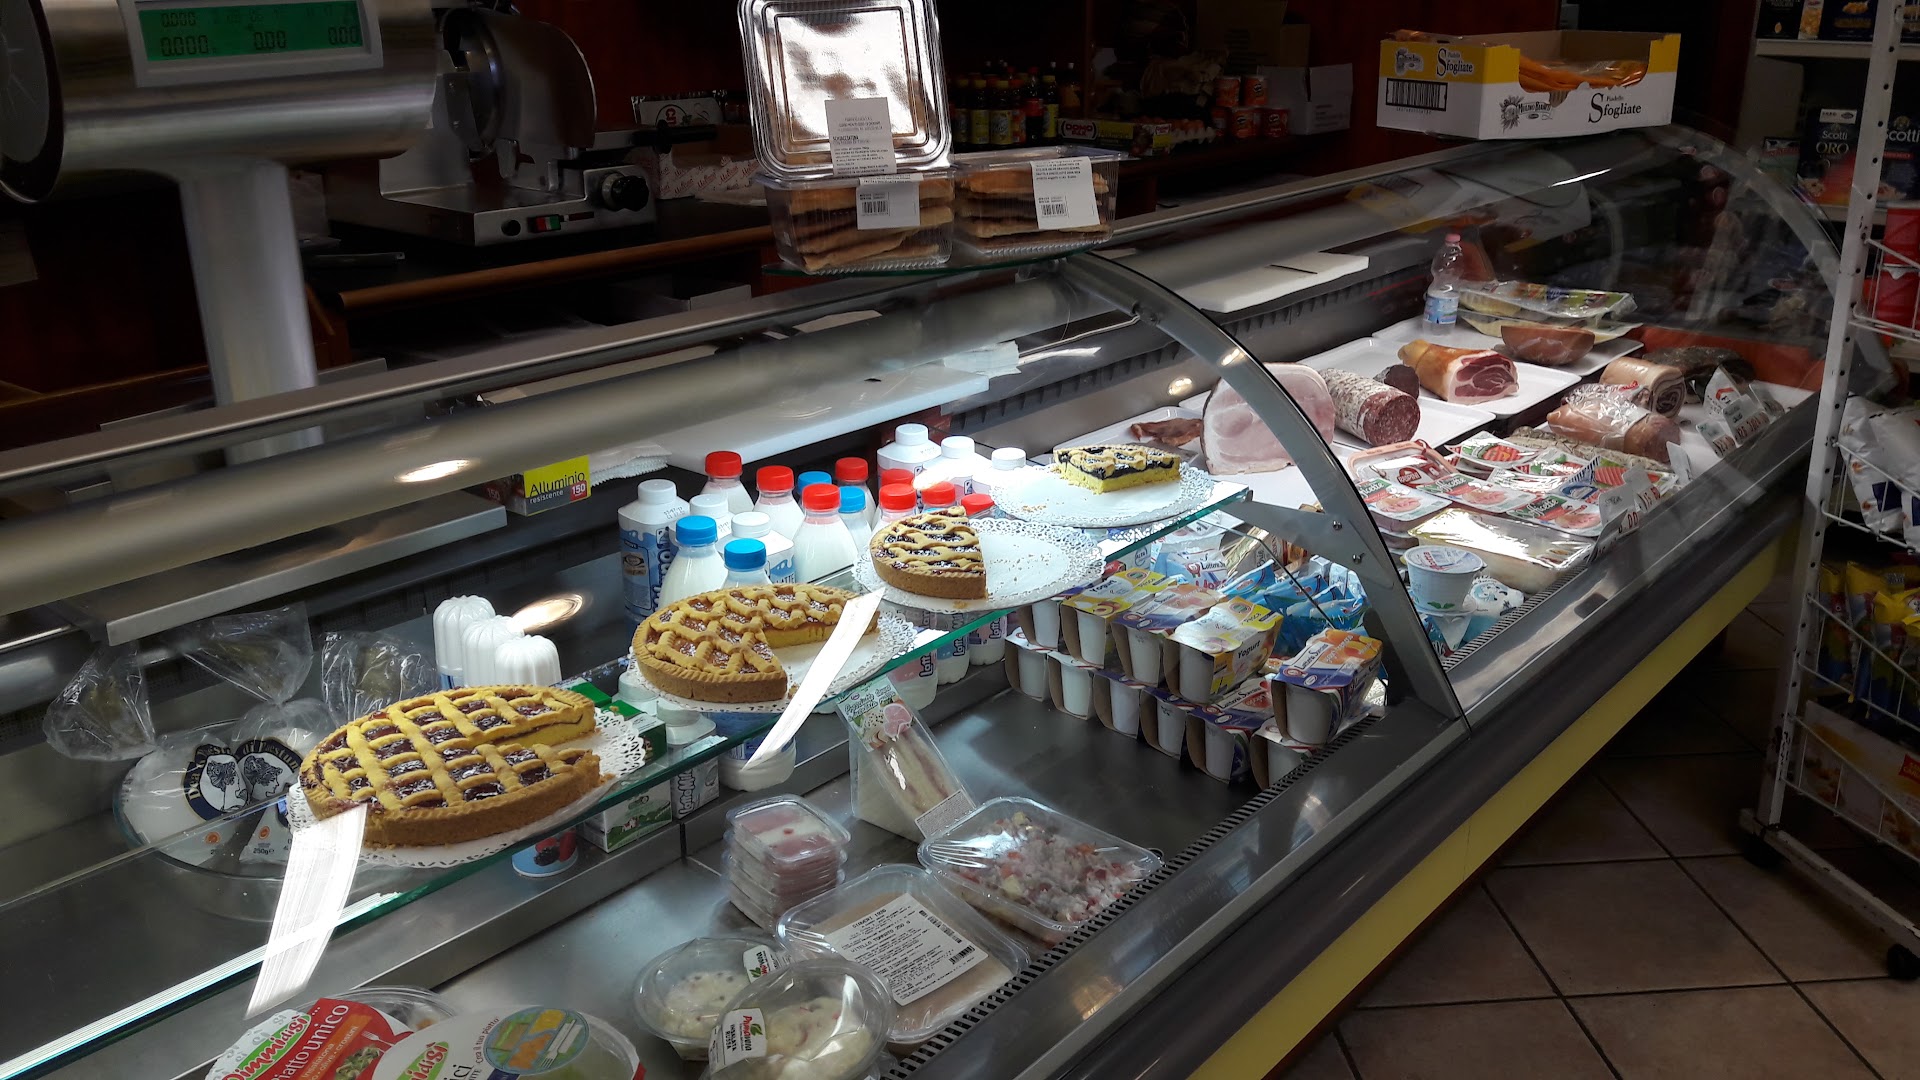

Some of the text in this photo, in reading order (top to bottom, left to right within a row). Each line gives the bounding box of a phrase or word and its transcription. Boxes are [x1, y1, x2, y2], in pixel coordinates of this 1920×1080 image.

[1436, 48, 1473, 77] Sfogliate
[1588, 92, 1641, 124] Sfogliate
[1822, 129, 1849, 141] Scotti
[1887, 128, 1920, 143] cotti
[1815, 141, 1850, 155] ORO
[530, 471, 585, 498] Alluminio
[571, 483, 586, 495] 150
[529, 489, 564, 504] resistente
[1237, 640, 1262, 660] Yogurt
[484, 1016, 501, 1035] piatto
[336, 1026, 360, 1052] crostini
[302, 1042, 335, 1079] Insalatona
